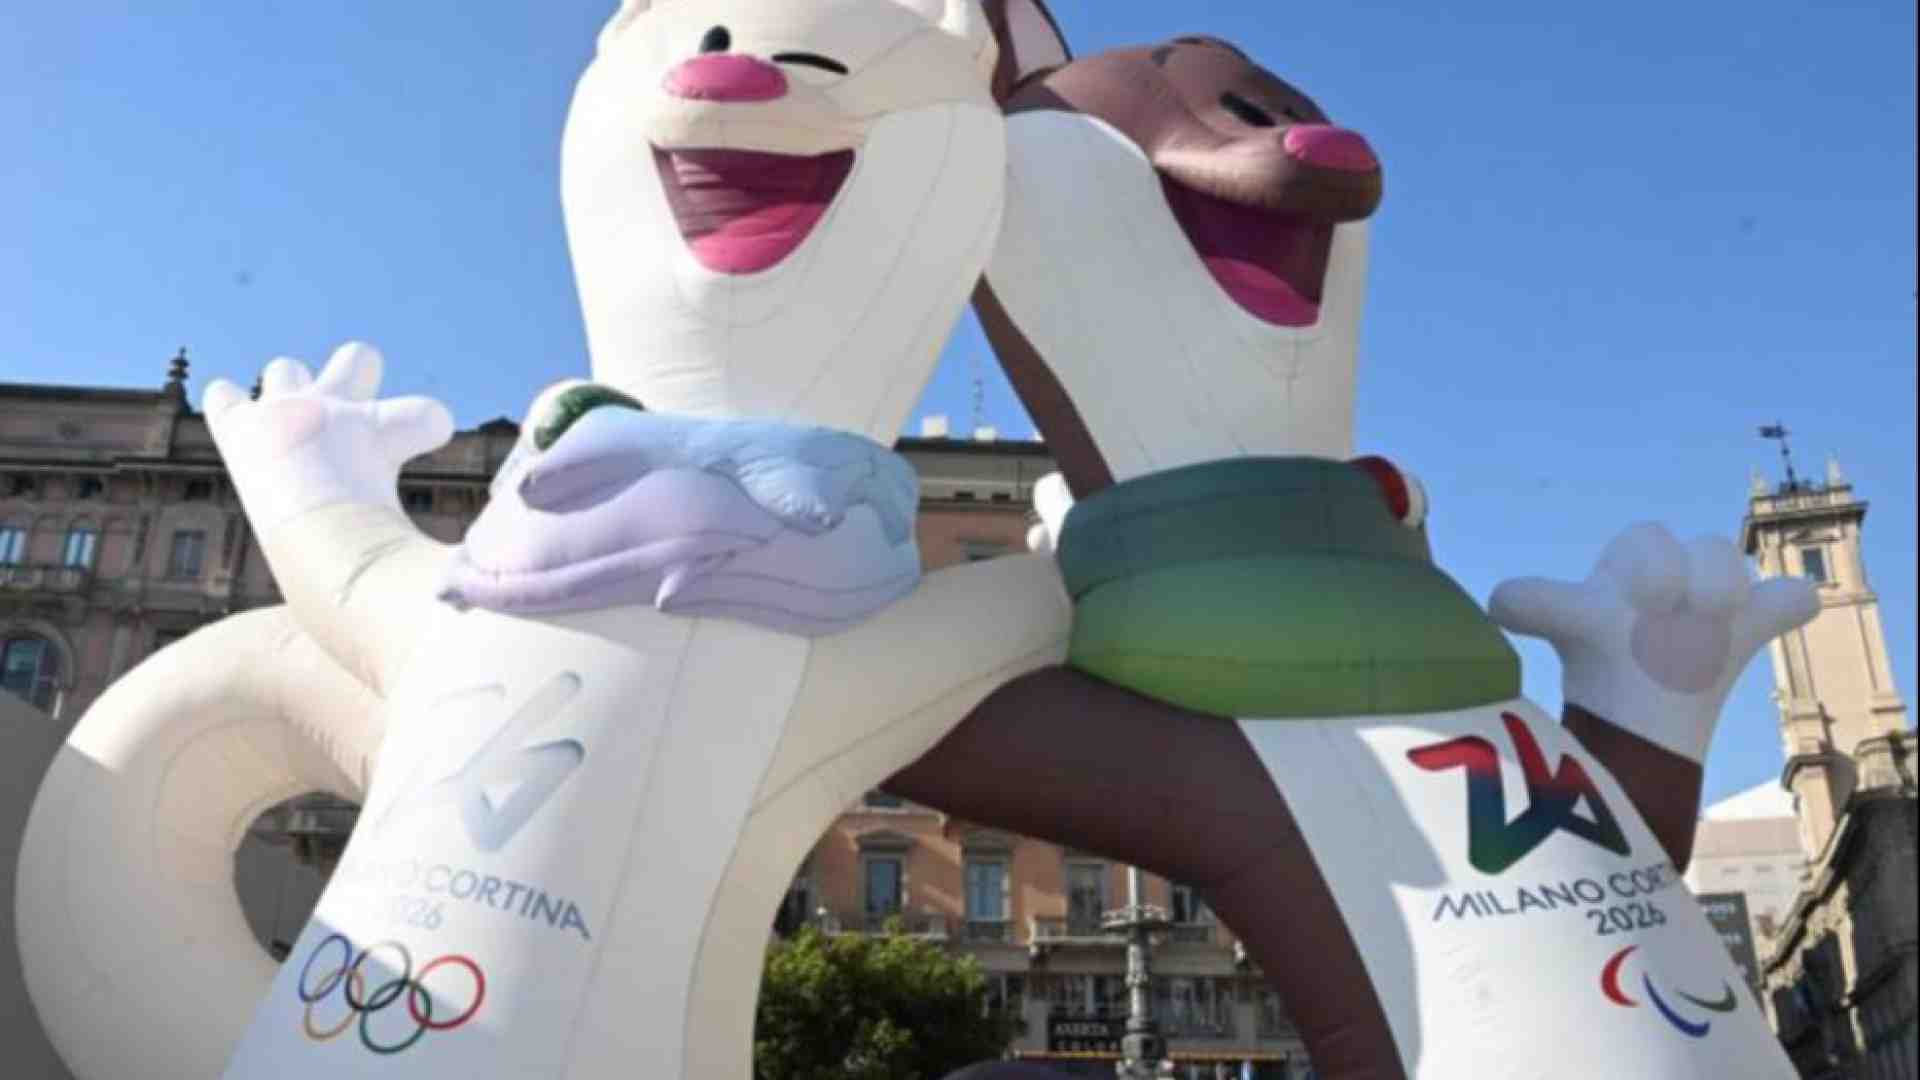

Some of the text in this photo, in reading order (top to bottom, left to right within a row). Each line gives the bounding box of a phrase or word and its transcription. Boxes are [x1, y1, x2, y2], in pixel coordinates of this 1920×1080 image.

[425, 864, 590, 940] CORTINA
[1432, 878, 1606, 921] MILANO
[1586, 902, 1667, 935] 2026
